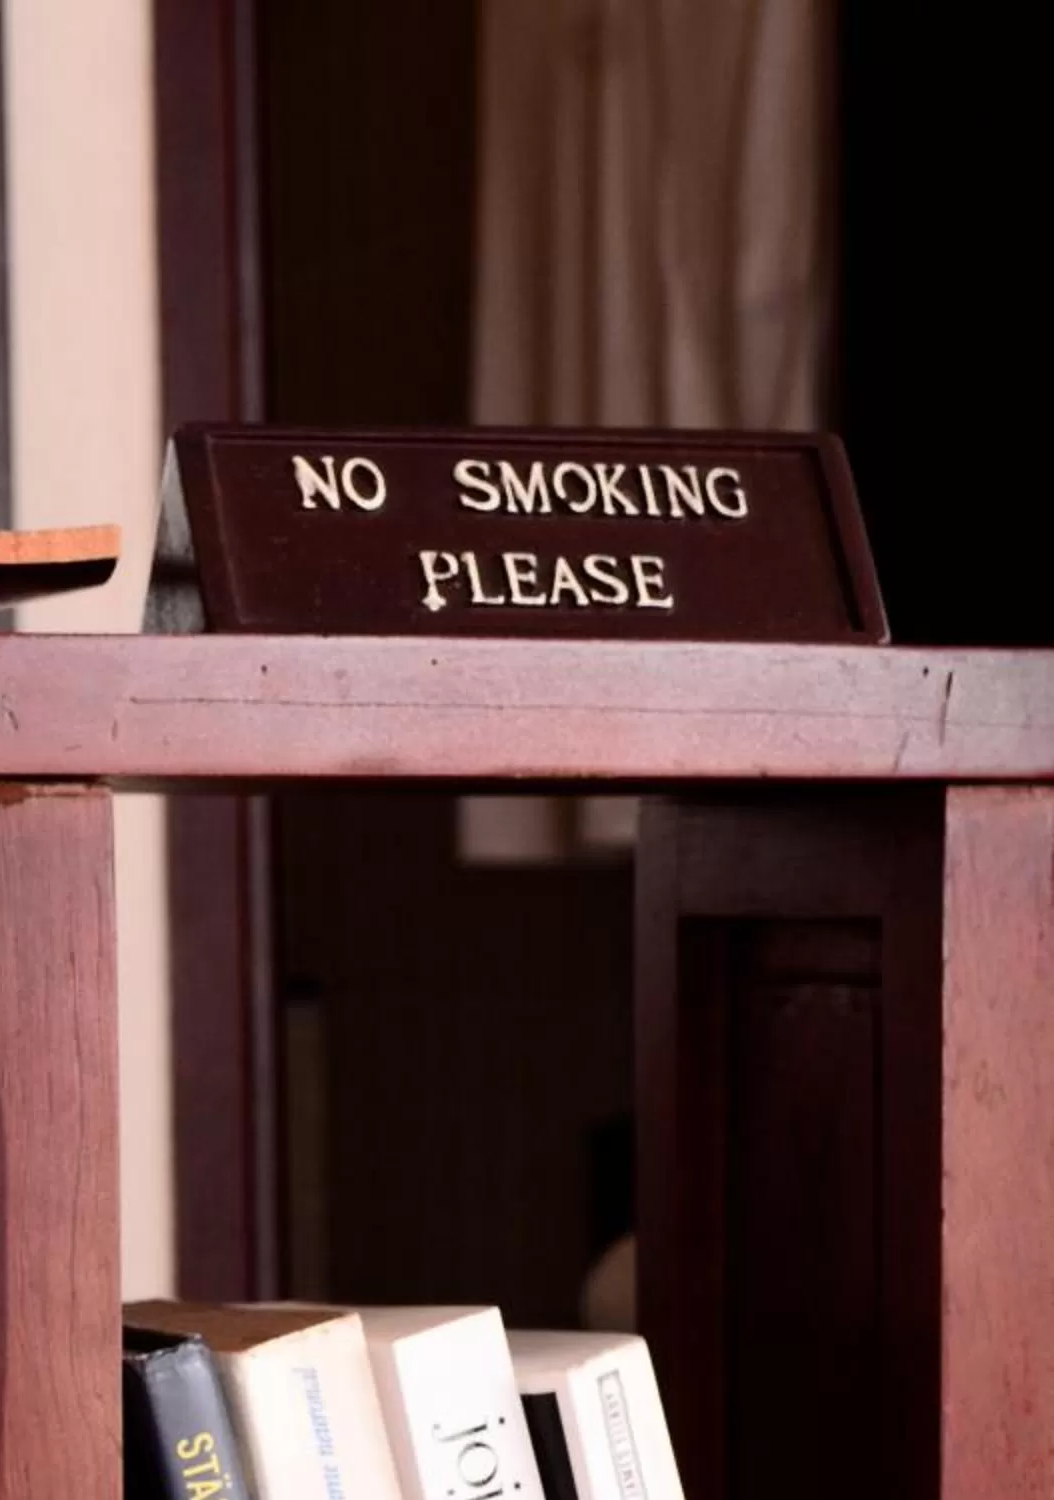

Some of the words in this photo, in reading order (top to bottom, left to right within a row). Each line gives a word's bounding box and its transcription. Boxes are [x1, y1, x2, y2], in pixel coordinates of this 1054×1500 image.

[292, 455, 387, 511] NO
[453, 459, 749, 519] SMOKING
[420, 550, 676, 612] PLEASE
